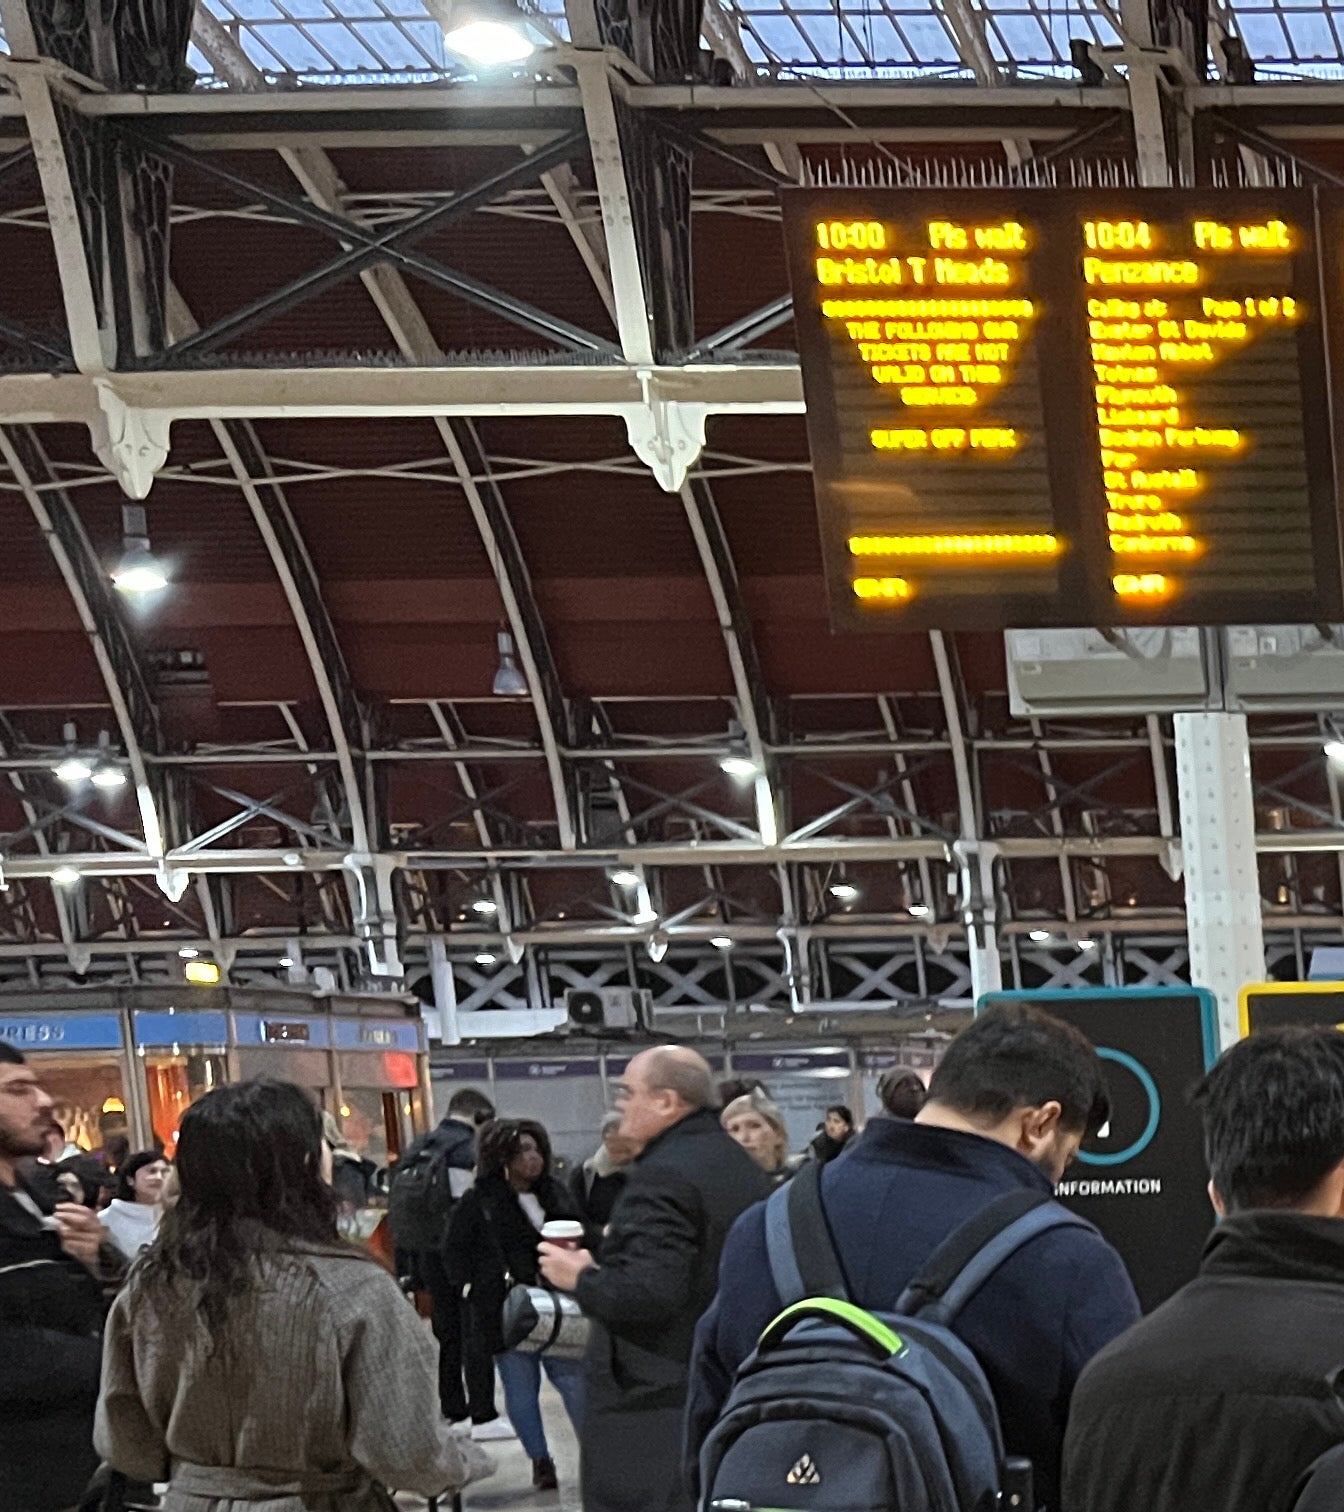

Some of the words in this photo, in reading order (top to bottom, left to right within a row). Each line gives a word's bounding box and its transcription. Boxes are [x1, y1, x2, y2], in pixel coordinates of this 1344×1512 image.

[817, 222, 886, 249] 10:00
[929, 222, 968, 249] Pls
[975, 223, 1026, 250] wait
[1085, 222, 1151, 249] 10:04
[1195, 222, 1233, 249] Pls
[1239, 221, 1289, 249] wait
[1084, 257, 1198, 285] Penzance
[1054, 1179, 1161, 1196] INFORMATION
